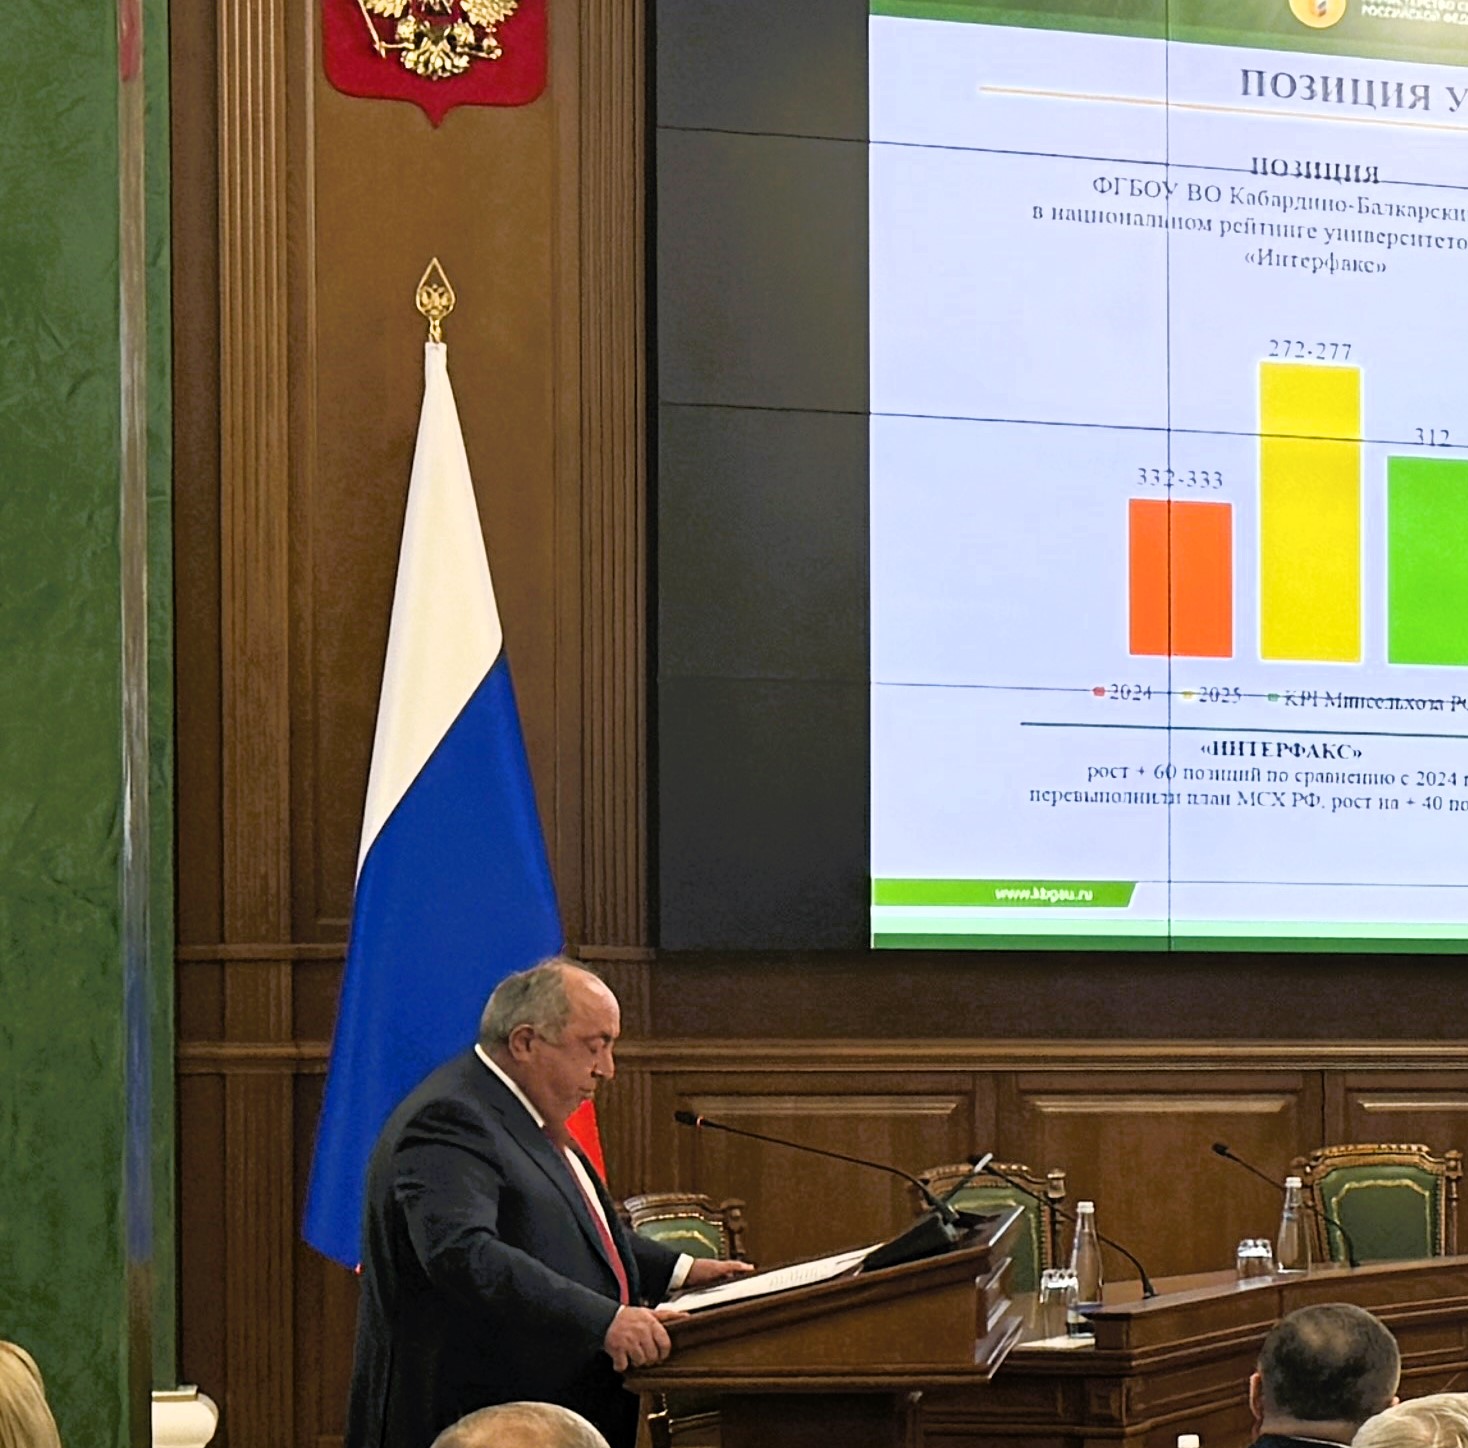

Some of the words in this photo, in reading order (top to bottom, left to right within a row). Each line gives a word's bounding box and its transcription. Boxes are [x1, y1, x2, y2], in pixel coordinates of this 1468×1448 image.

[1240, 68, 1431, 111] ПОЗИЦИЯ
[1251, 157, 1380, 185] ПОЗИЦИЯ
[1093, 177, 1178, 199] ФГБОУ
[1187, 183, 1221, 202] ВО
[1032, 205, 1043, 219] в
[1051, 206, 1212, 231] национальном
[1220, 217, 1318, 239] рейтинге
[1244, 248, 1387, 275] «Интерфакс»
[1268, 339, 1352, 361] 272-277
[1415, 427, 1450, 447] 312
[1137, 467, 1223, 490] 332-333
[1110, 684, 1152, 700] 2024
[1199, 686, 1242, 704] 2025
[1284, 690, 1317, 708] KPI
[1325, 691, 1444, 712] Минсельхоза
[1201, 740, 1362, 760] «ИНТЕРФАКС»
[1087, 766, 1130, 782] рост
[1154, 764, 1177, 780] 60
[1183, 766, 1261, 783] позиций
[1267, 769, 1289, 783] по
[1295, 771, 1396, 788] сравнению
[1400, 774, 1410, 787] с
[1416, 770, 1457, 788] 2024
[1030, 788, 1181, 807] перевыполнили
[1187, 791, 1231, 807] план
[1237, 791, 1286, 808] МСХ
[1331, 796, 1372, 814] рост
[1378, 798, 1399, 811] на
[1422, 795, 1443, 812] 40
